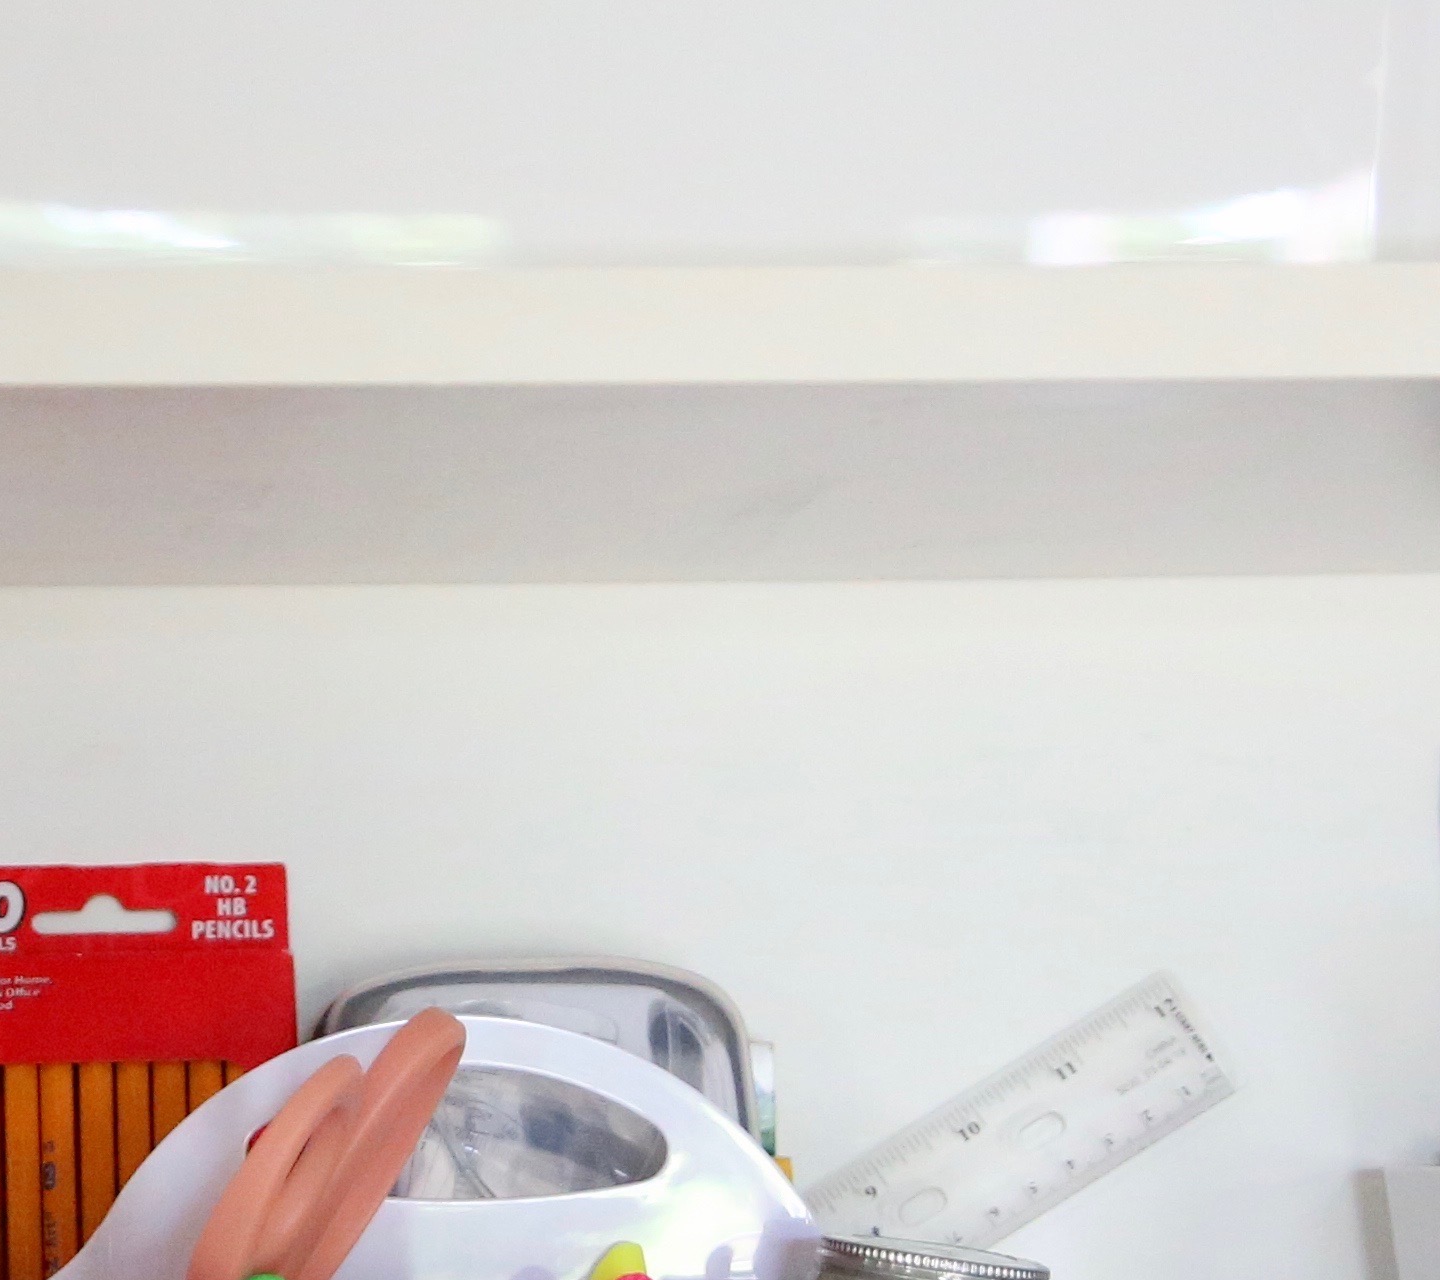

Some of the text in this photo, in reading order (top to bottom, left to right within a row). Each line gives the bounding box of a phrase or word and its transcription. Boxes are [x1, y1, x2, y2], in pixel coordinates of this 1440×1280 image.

[204, 874, 258, 895] NO. 2
[217, 897, 247, 916] HB
[191, 919, 275, 940] PENCILS
[1053, 1061, 1079, 1082] 11
[956, 1121, 982, 1143] 10
